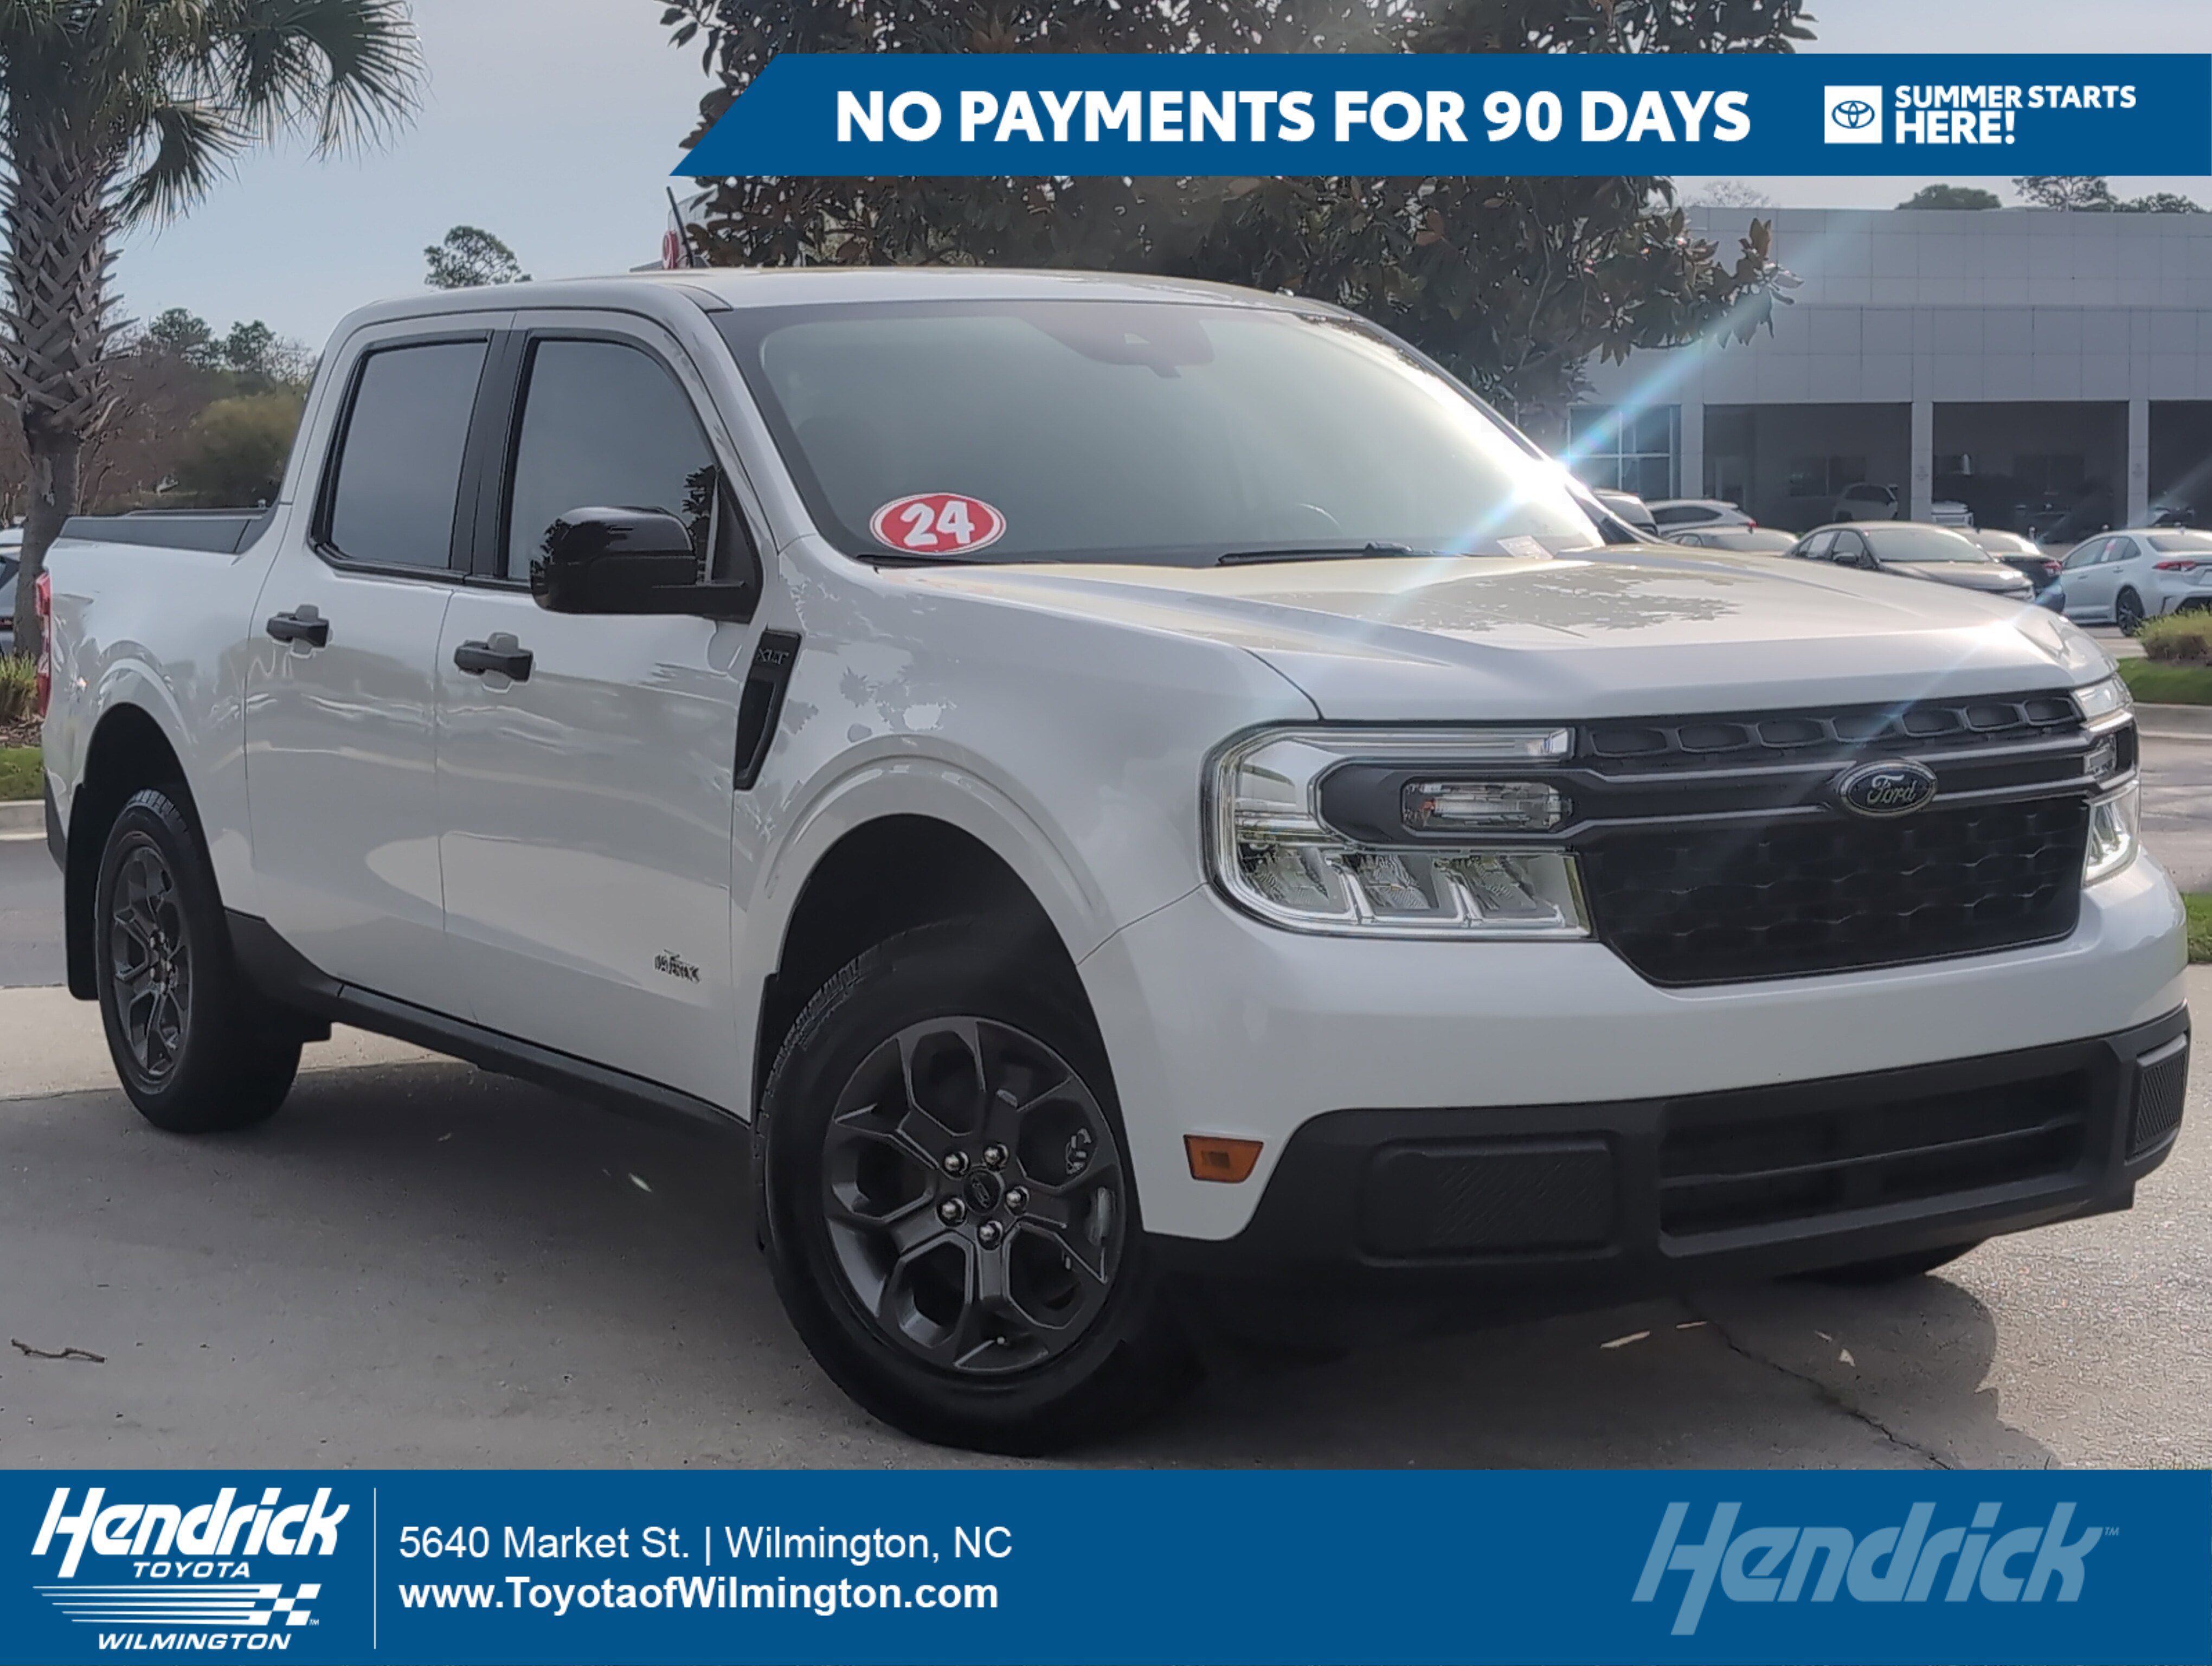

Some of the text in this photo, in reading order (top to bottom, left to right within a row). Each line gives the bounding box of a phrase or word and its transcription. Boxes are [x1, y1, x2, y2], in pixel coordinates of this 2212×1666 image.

[900, 500, 975, 547] 24
[757, 648, 789, 665] XLT
[1867, 774, 1918, 805] Ford
